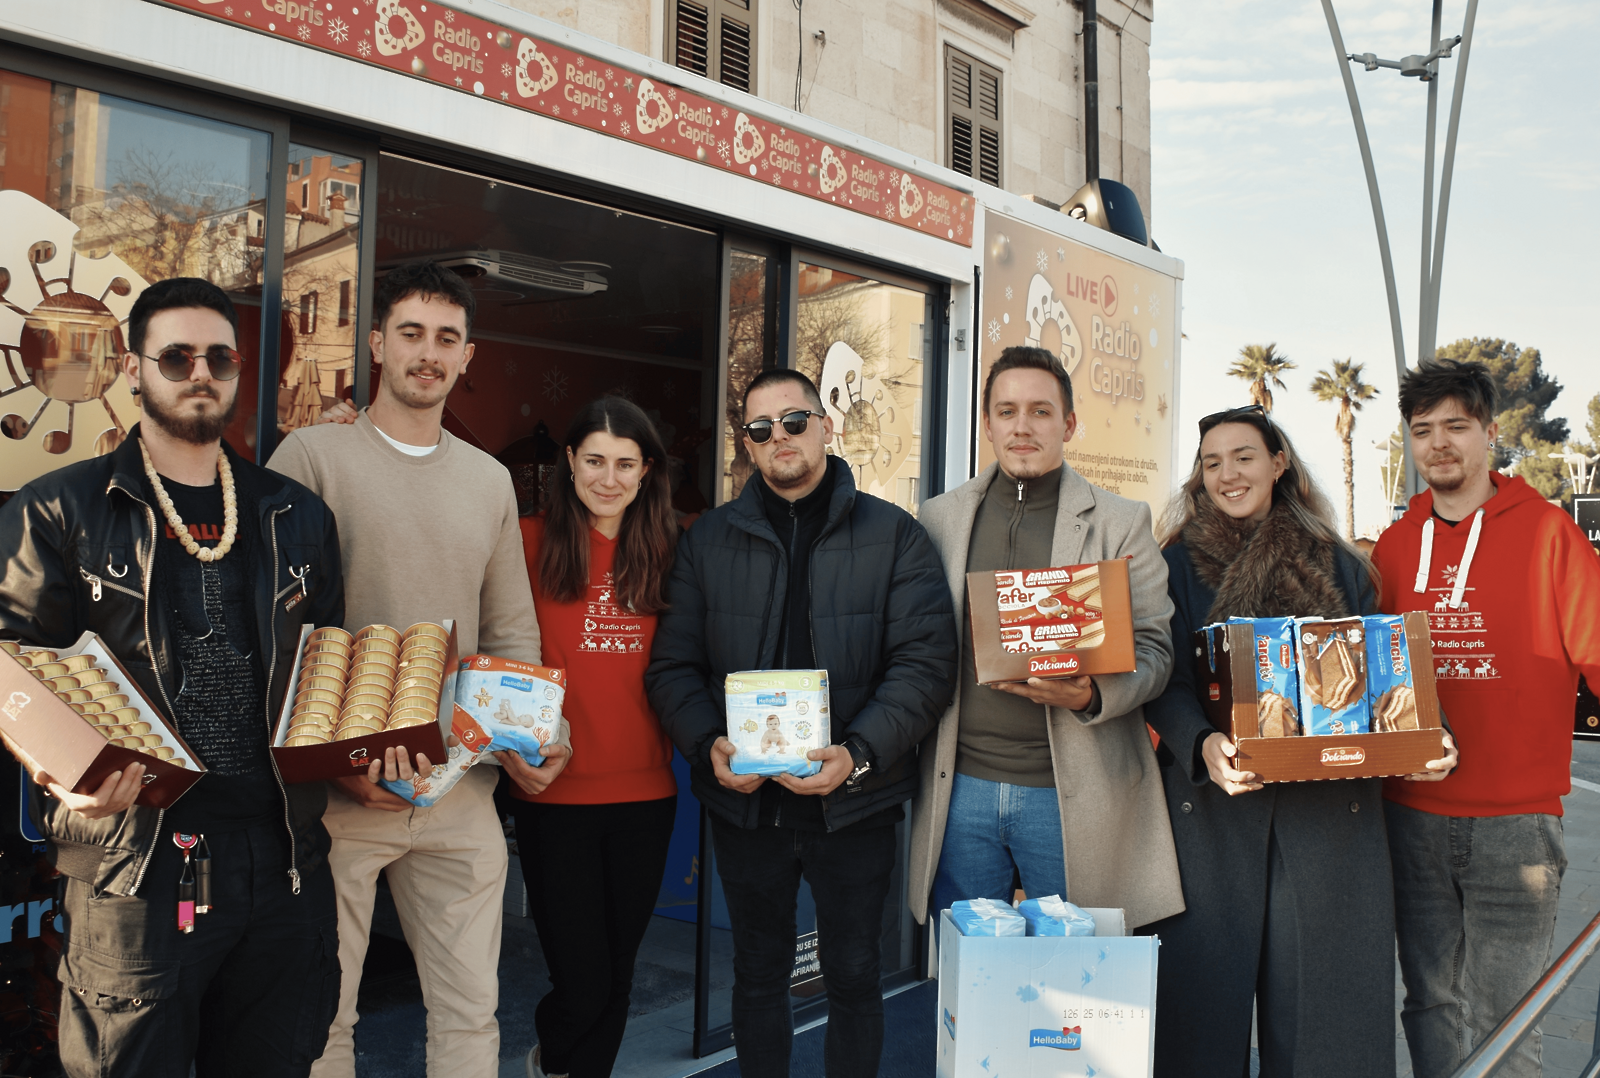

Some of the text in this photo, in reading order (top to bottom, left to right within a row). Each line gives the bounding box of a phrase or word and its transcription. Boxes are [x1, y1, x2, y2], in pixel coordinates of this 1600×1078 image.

[434, 20, 480, 52] Radio
[432, 43, 484, 75] Capris
[565, 63, 606, 92] Radio
[564, 84, 608, 113] Capris
[678, 101, 714, 128] Radio
[677, 121, 715, 147] Capris
[769, 132, 801, 157] Radio
[768, 150, 802, 175] Capris
[851, 164, 878, 187] Radio
[850, 180, 880, 203] Capris
[926, 190, 950, 211] Radio
[925, 205, 951, 226] Capris
[1066, 272, 1098, 305] LIVE
[1090, 314, 1141, 361] Radio
[1090, 356, 1145, 405] Capris
[1078, 452, 1110, 467] namenjeni
[1109, 455, 1135, 467] otrokom
[1134, 457, 1140, 469] iz
[1095, 467, 1101, 479] in
[1101, 468, 1127, 483] prihajajo
[1126, 471, 1132, 482] iz
[1026, 570, 1069, 582] GRANDI
[599, 623, 641, 632] Radio Capris
[1034, 623, 1078, 636] GRANDI
[1390, 623, 1406, 676] Farciti
[1437, 639, 1485, 650] Radio Capris
[479, 658, 489, 666] 24
[1030, 657, 1078, 672] Dolciando
[502, 679, 531, 690] HelloBaby
[758, 697, 785, 705] HelloBaby
[465, 731, 474, 741] 2
[1320, 751, 1363, 763] Dolciando
[804, 940, 812, 950] SE
[812, 938, 818, 947] IZ
[791, 961, 820, 977] AFIRANJE
[1063, 1008, 1145, 1019] 126 25 06:41 1 1
[1033, 1035, 1078, 1046] HelloBaby
